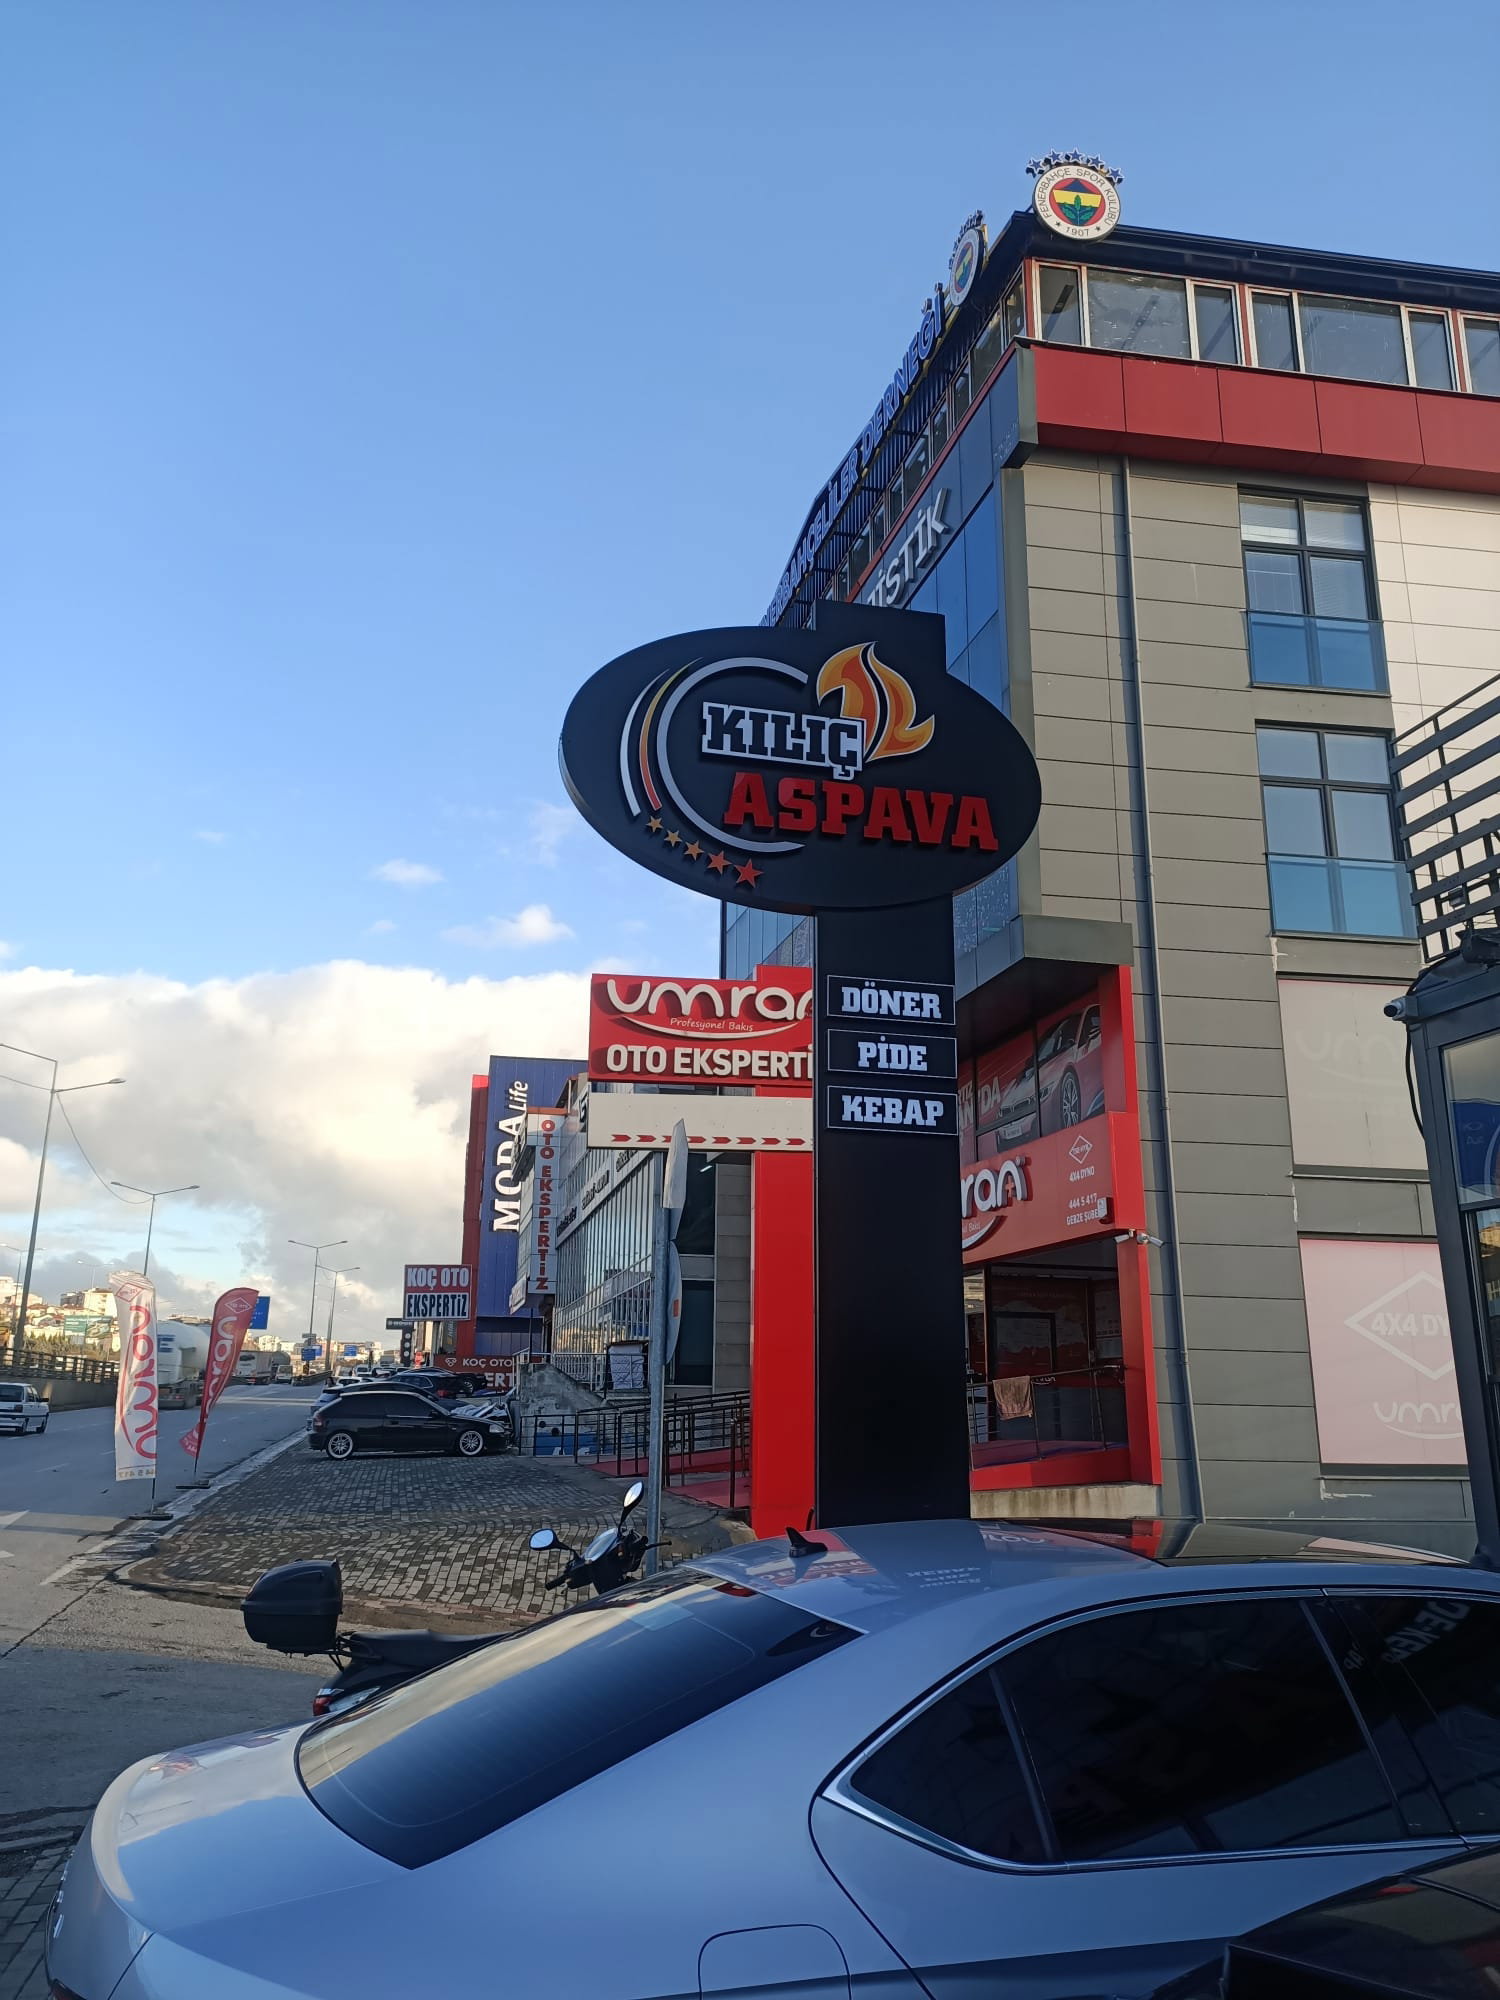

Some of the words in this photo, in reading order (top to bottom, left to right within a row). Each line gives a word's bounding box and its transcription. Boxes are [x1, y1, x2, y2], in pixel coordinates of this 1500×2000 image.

[1038, 167, 1071, 218] FENERBAHÇE
[1076, 168, 1106, 188] SPOR
[1066, 226, 1089, 237] 1907
[861, 282, 943, 465] DERNEĞİ
[702, 701, 866, 781] KILIÇ
[724, 772, 999, 851] ASPAVA
[841, 981, 942, 1019] DÖNER
[670, 1017, 725, 1031] Profesyonel
[606, 1044, 667, 1073] OTO
[858, 1035, 928, 1072] PİDE
[508, 1080, 528, 1111] Life
[841, 1094, 944, 1126] KEBAP
[541, 1119, 555, 1159] OTO
[493, 1109, 526, 1232] MODA
[1081, 1165, 1095, 1179] DYNO
[536, 1165, 553, 1290] EKSPERTİZ
[407, 1268, 437, 1290] KOÇ
[441, 1268, 470, 1288] OTO
[407, 1294, 467, 1317] EKSPERTİZ
[1371, 1312, 1417, 1336] 4X4
[462, 1358, 487, 1368] KOÇ
[489, 1358, 513, 1368] OTO
